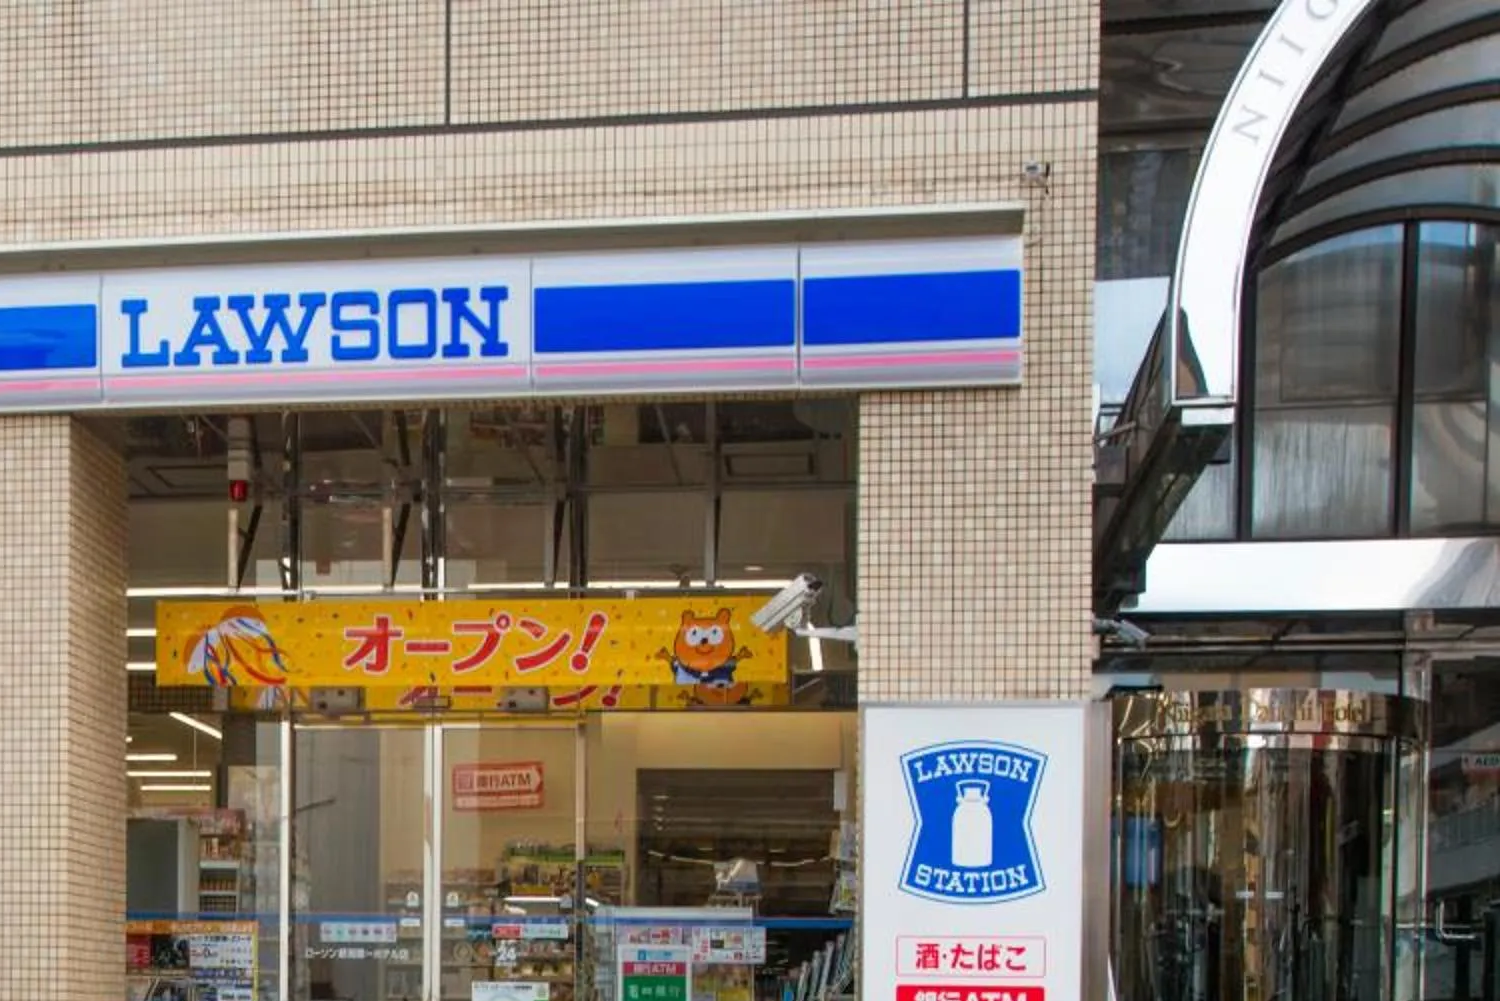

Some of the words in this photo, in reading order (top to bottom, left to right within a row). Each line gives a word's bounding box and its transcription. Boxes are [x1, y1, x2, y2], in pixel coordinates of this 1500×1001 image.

[121, 286, 508, 367] LAWSON
[343, 612, 607, 672] オープン!
[913, 753, 1033, 782] LAWSON
[913, 864, 1029, 893] STATION
